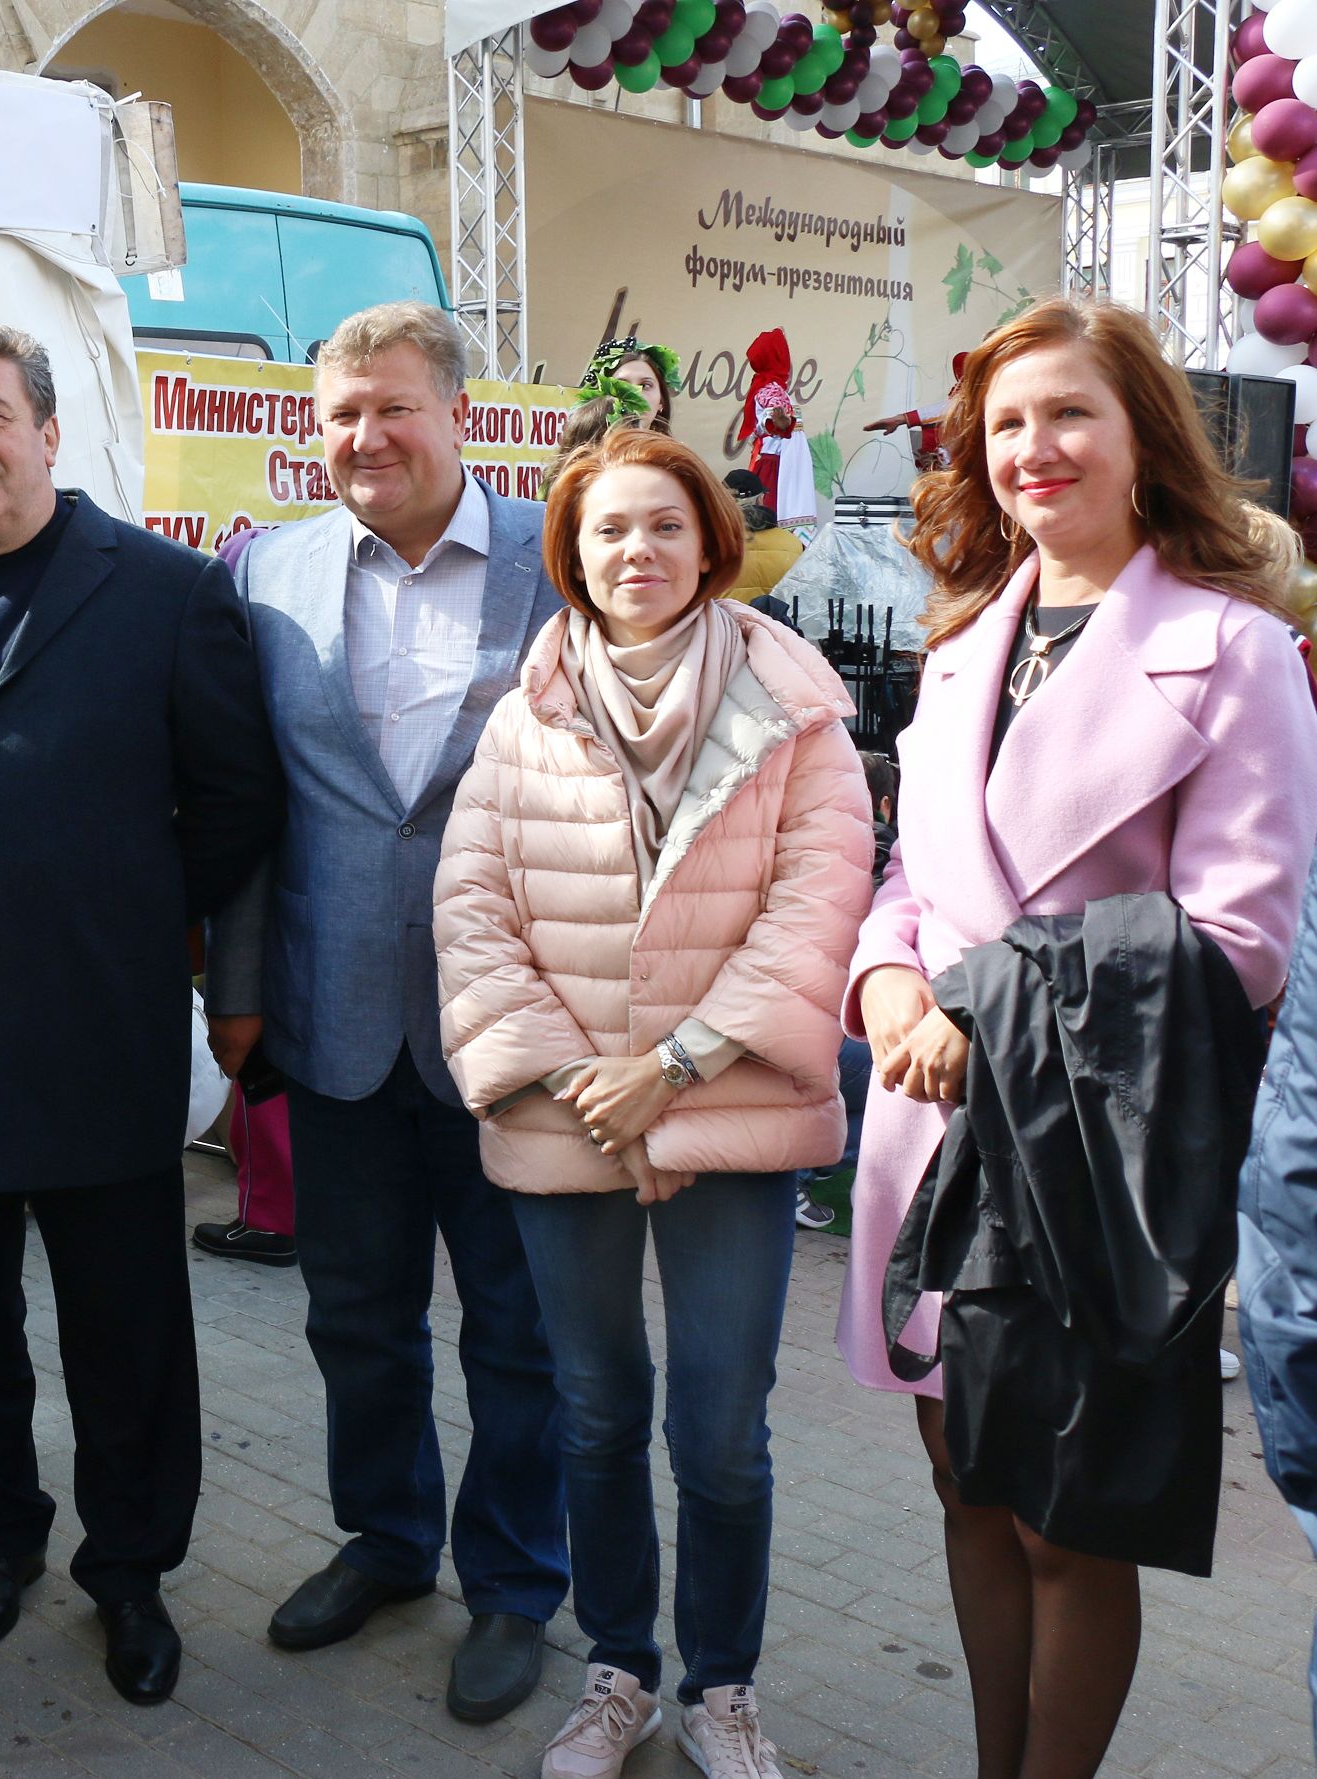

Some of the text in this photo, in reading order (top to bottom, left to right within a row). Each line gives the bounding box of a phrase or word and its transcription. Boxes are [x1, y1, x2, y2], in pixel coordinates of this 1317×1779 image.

[698, 189, 906, 252] Международный
[685, 244, 914, 301] форум-презентация
[155, 376, 323, 445] Министер
